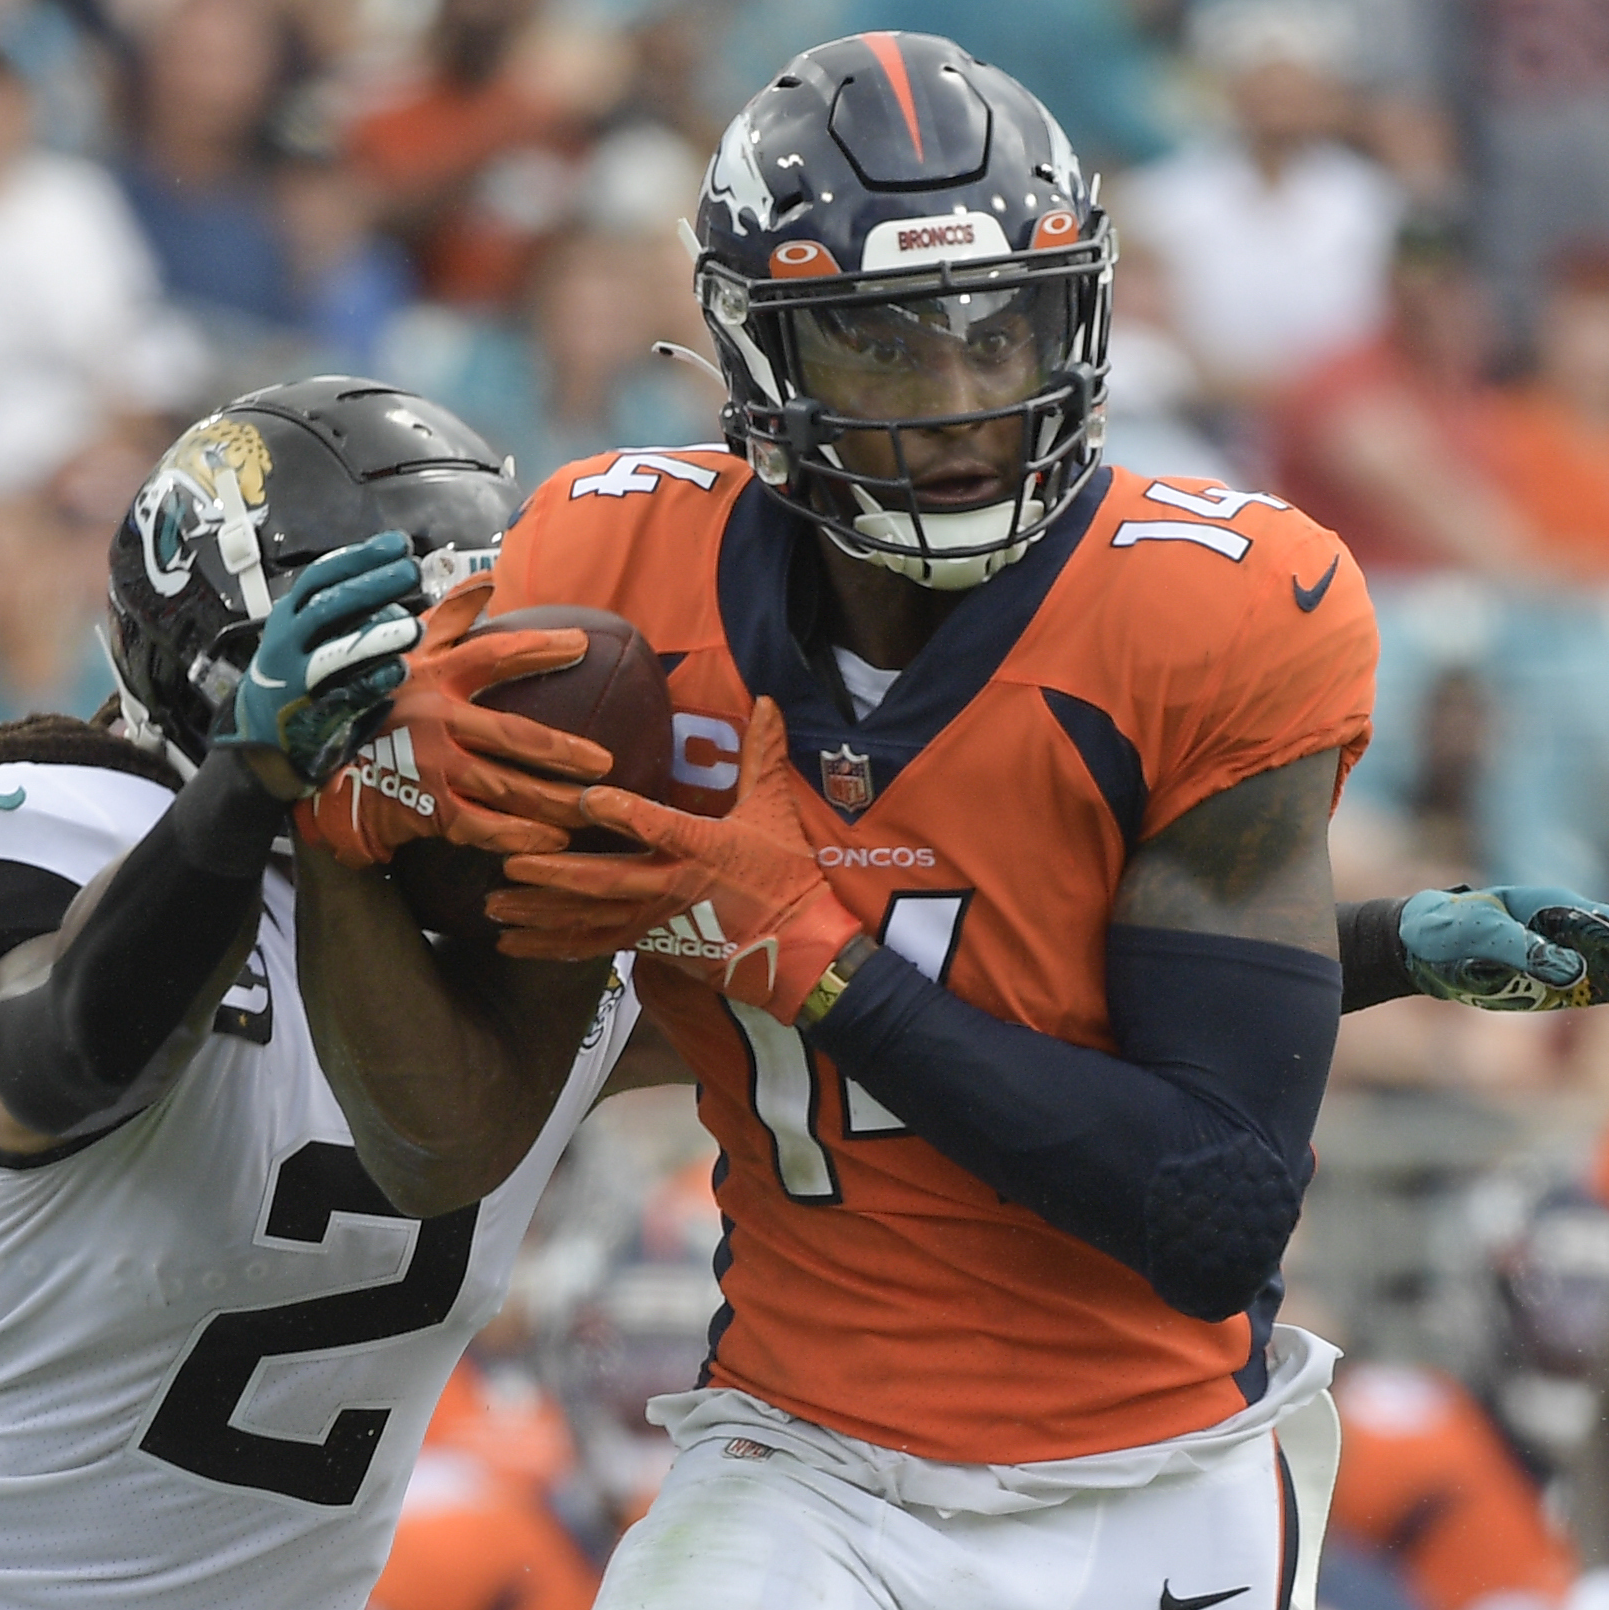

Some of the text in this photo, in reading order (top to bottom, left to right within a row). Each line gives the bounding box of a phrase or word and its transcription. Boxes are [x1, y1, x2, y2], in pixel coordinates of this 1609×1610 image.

[898, 224, 974, 251] BRONCOS
[1110, 480, 1294, 563] 14
[672, 712, 740, 791] C
[817, 845, 936, 868] ONCOS
[126, 1134, 483, 1512] 2
